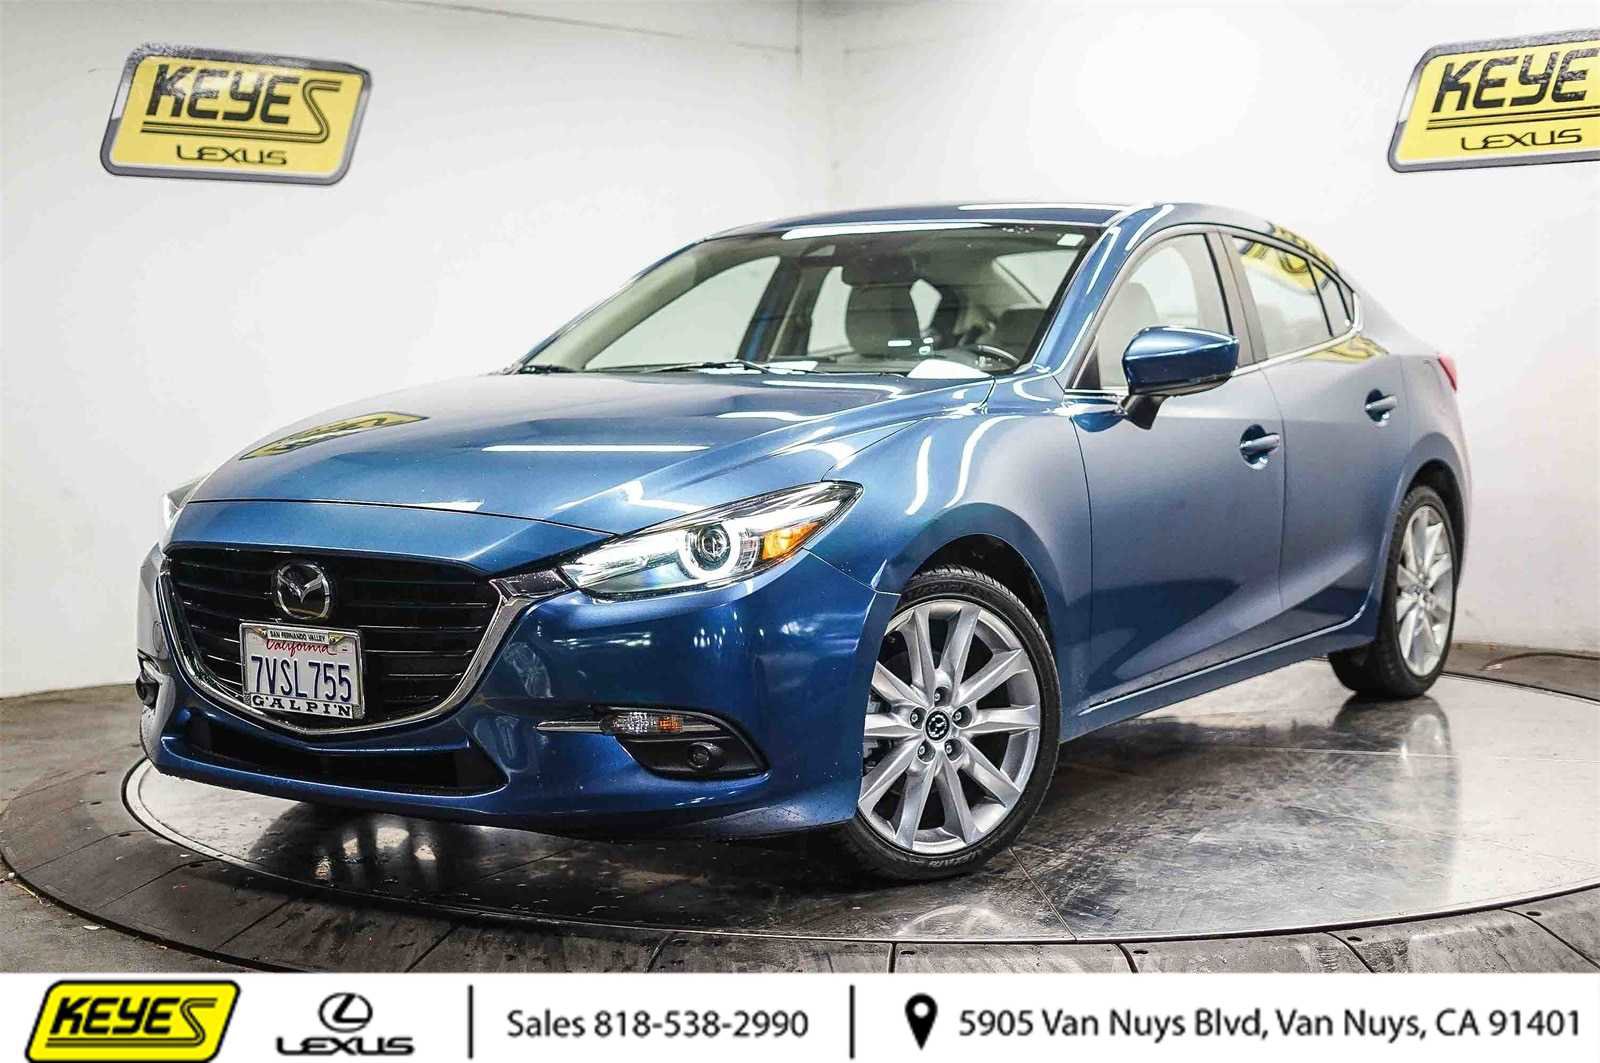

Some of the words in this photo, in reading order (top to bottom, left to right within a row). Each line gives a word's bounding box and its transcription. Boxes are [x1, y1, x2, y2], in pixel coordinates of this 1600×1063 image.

[144, 63, 342, 143] KEYES
[1461, 128, 1583, 151] LEXUS
[176, 145, 287, 165] LEXUS
[270, 630, 280, 638] SAN
[281, 631, 307, 641] FERNANDO
[308, 633, 325, 642] VALLEY
[251, 656, 351, 702] 7VSL755
